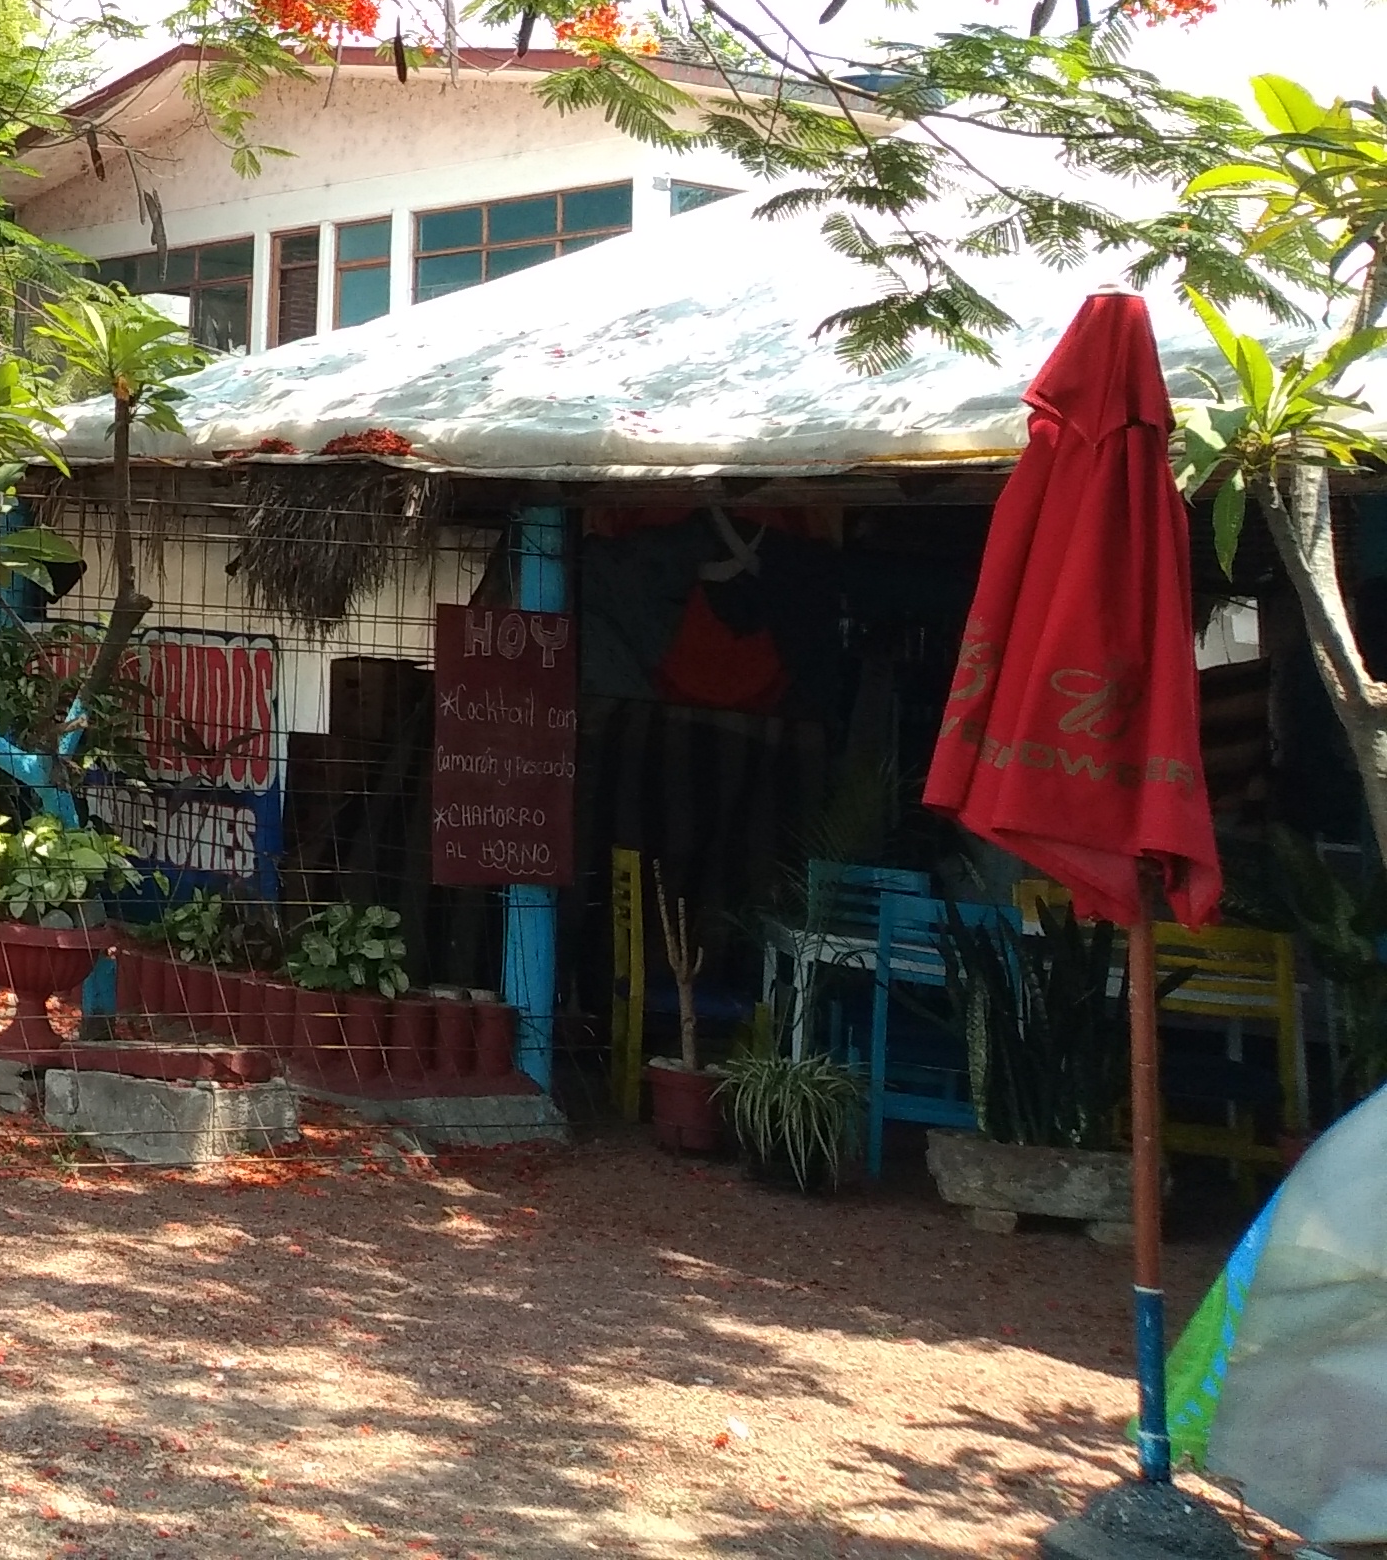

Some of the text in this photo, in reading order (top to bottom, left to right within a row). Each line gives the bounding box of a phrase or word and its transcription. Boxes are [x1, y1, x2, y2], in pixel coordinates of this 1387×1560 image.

[463, 609, 569, 668] HOY
[547, 706, 578, 732] con
[498, 758, 512, 786] y
[445, 839, 551, 865] AL HORNO
